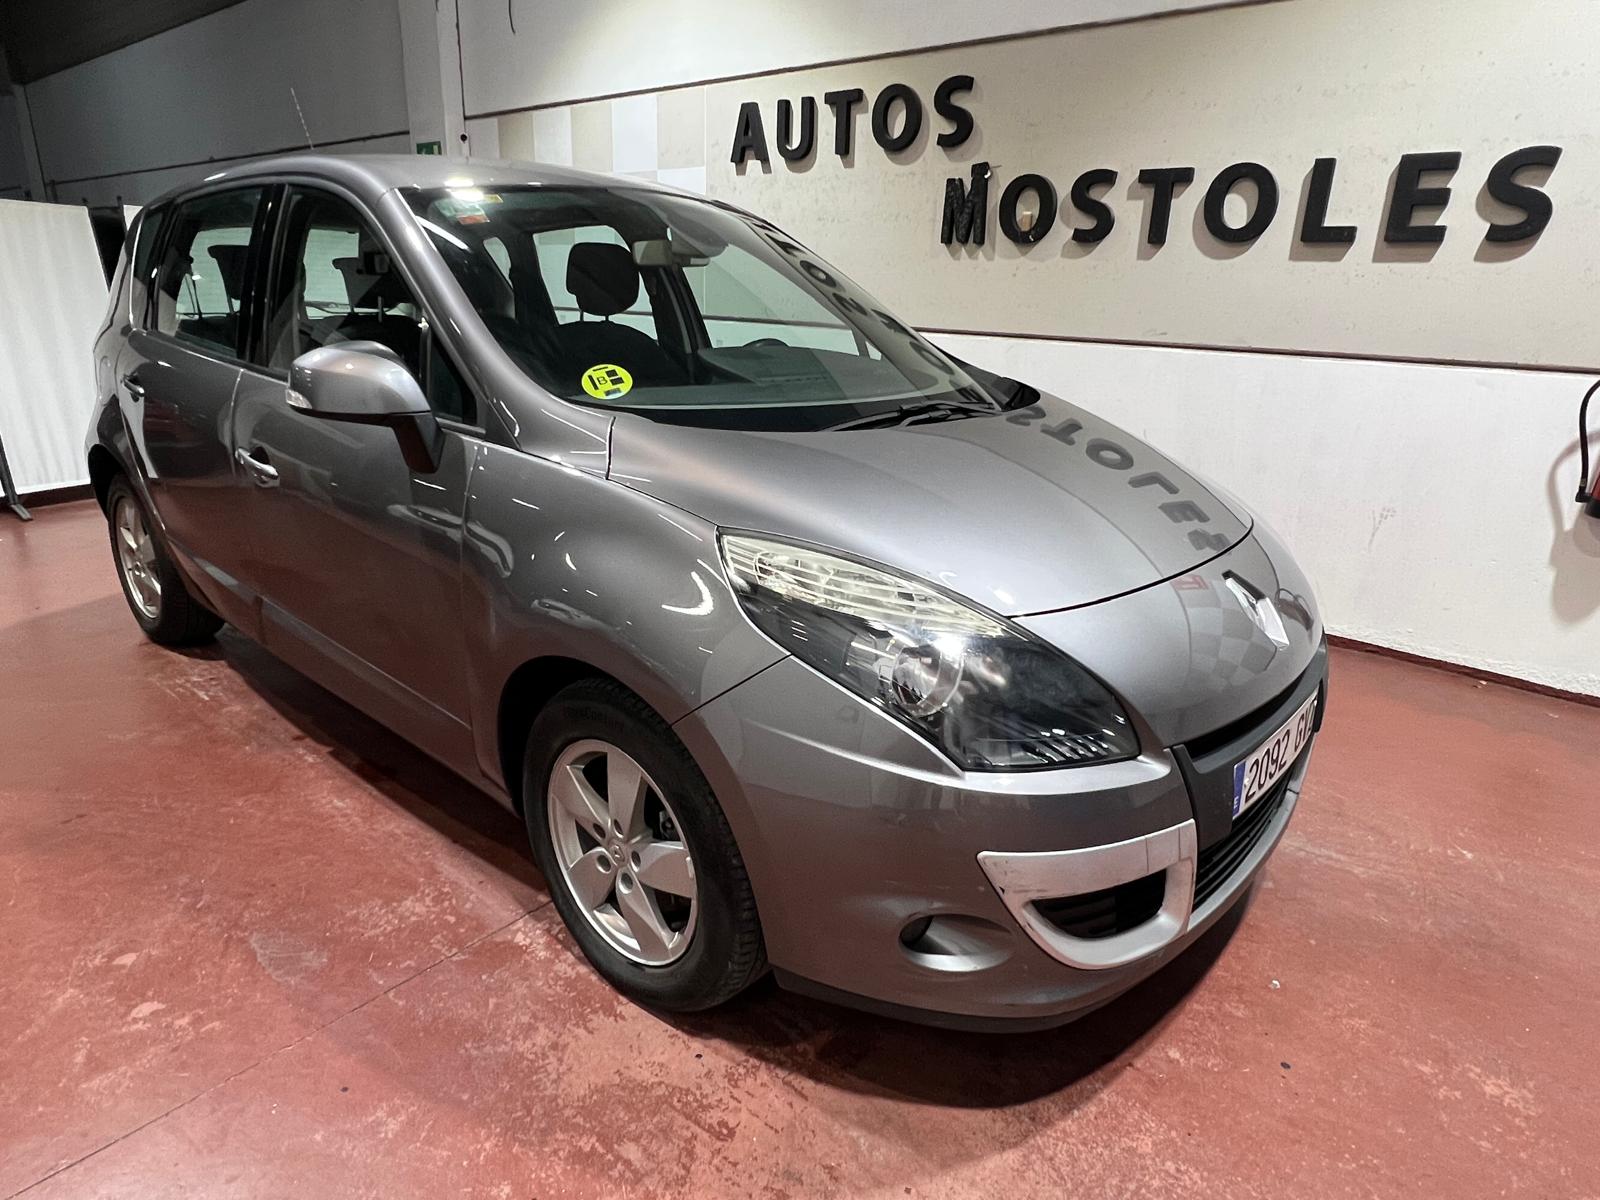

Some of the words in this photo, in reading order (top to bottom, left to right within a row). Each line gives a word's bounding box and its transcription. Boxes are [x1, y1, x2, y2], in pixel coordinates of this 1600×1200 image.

[730, 75, 975, 164] AUTOS
[940, 144, 1562, 246] MOSTOLES
[1244, 729, 1291, 804] 2092
